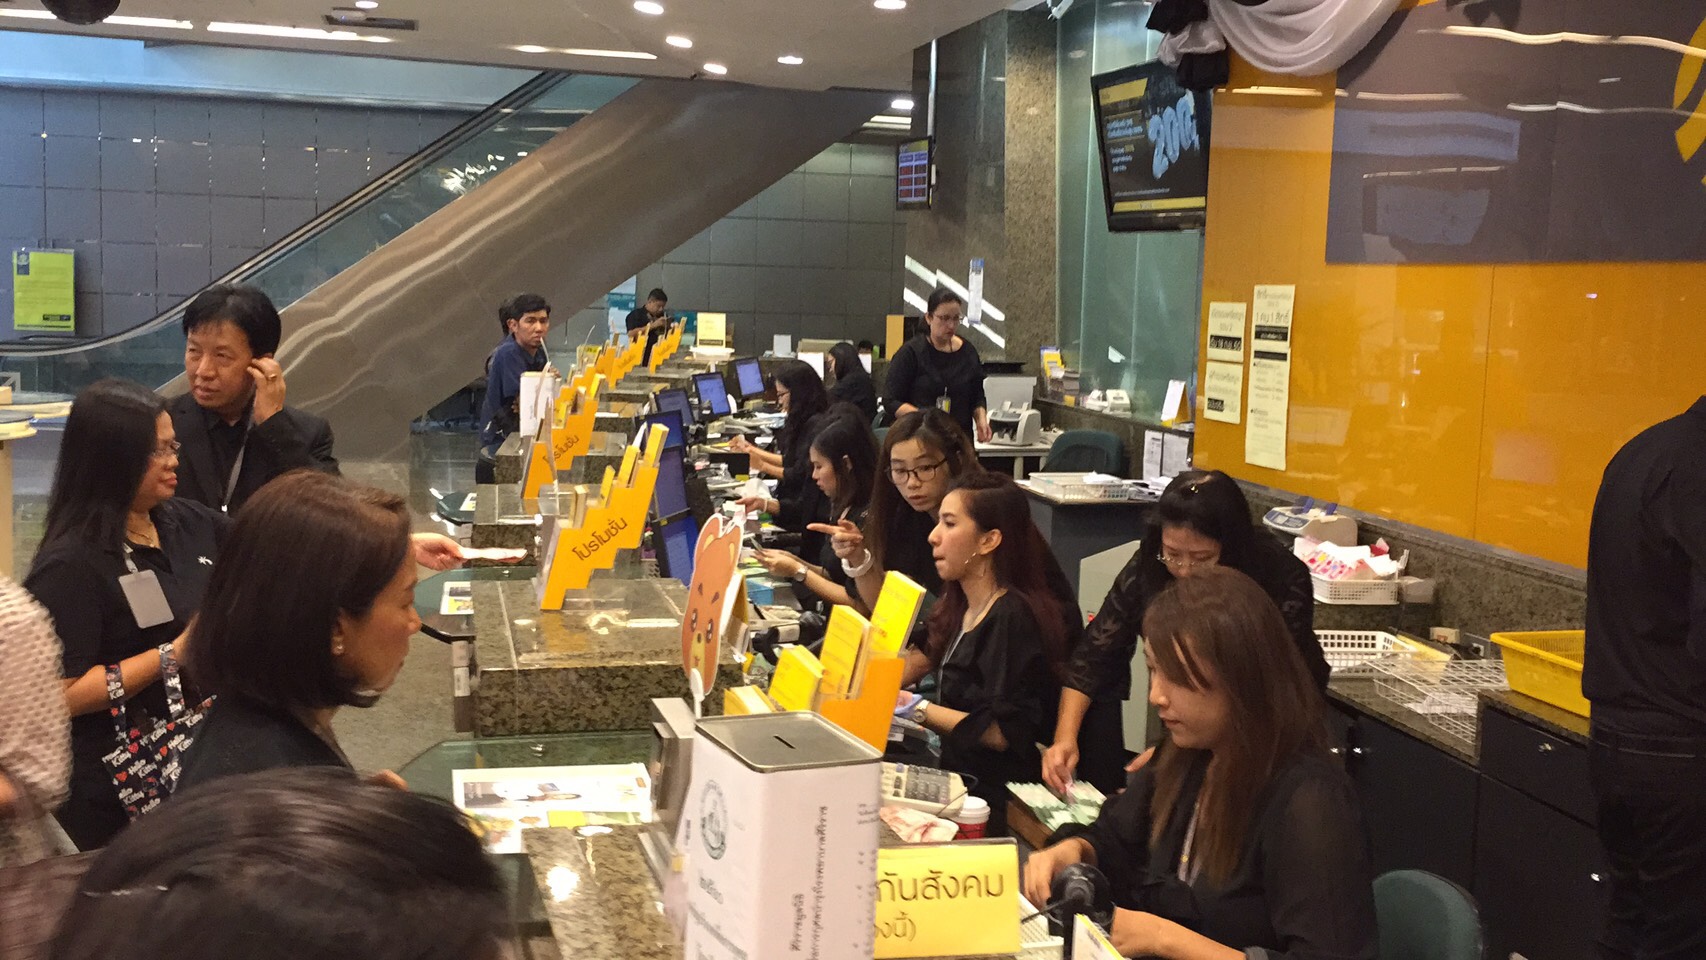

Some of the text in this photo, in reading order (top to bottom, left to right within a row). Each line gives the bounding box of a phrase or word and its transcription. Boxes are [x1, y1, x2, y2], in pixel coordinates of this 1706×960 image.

[571, 516, 629, 562] โปรโมชั่น
[128, 758, 147, 776] Hello
[122, 790, 145, 806] Kitty
[141, 797, 161, 815] Hello
